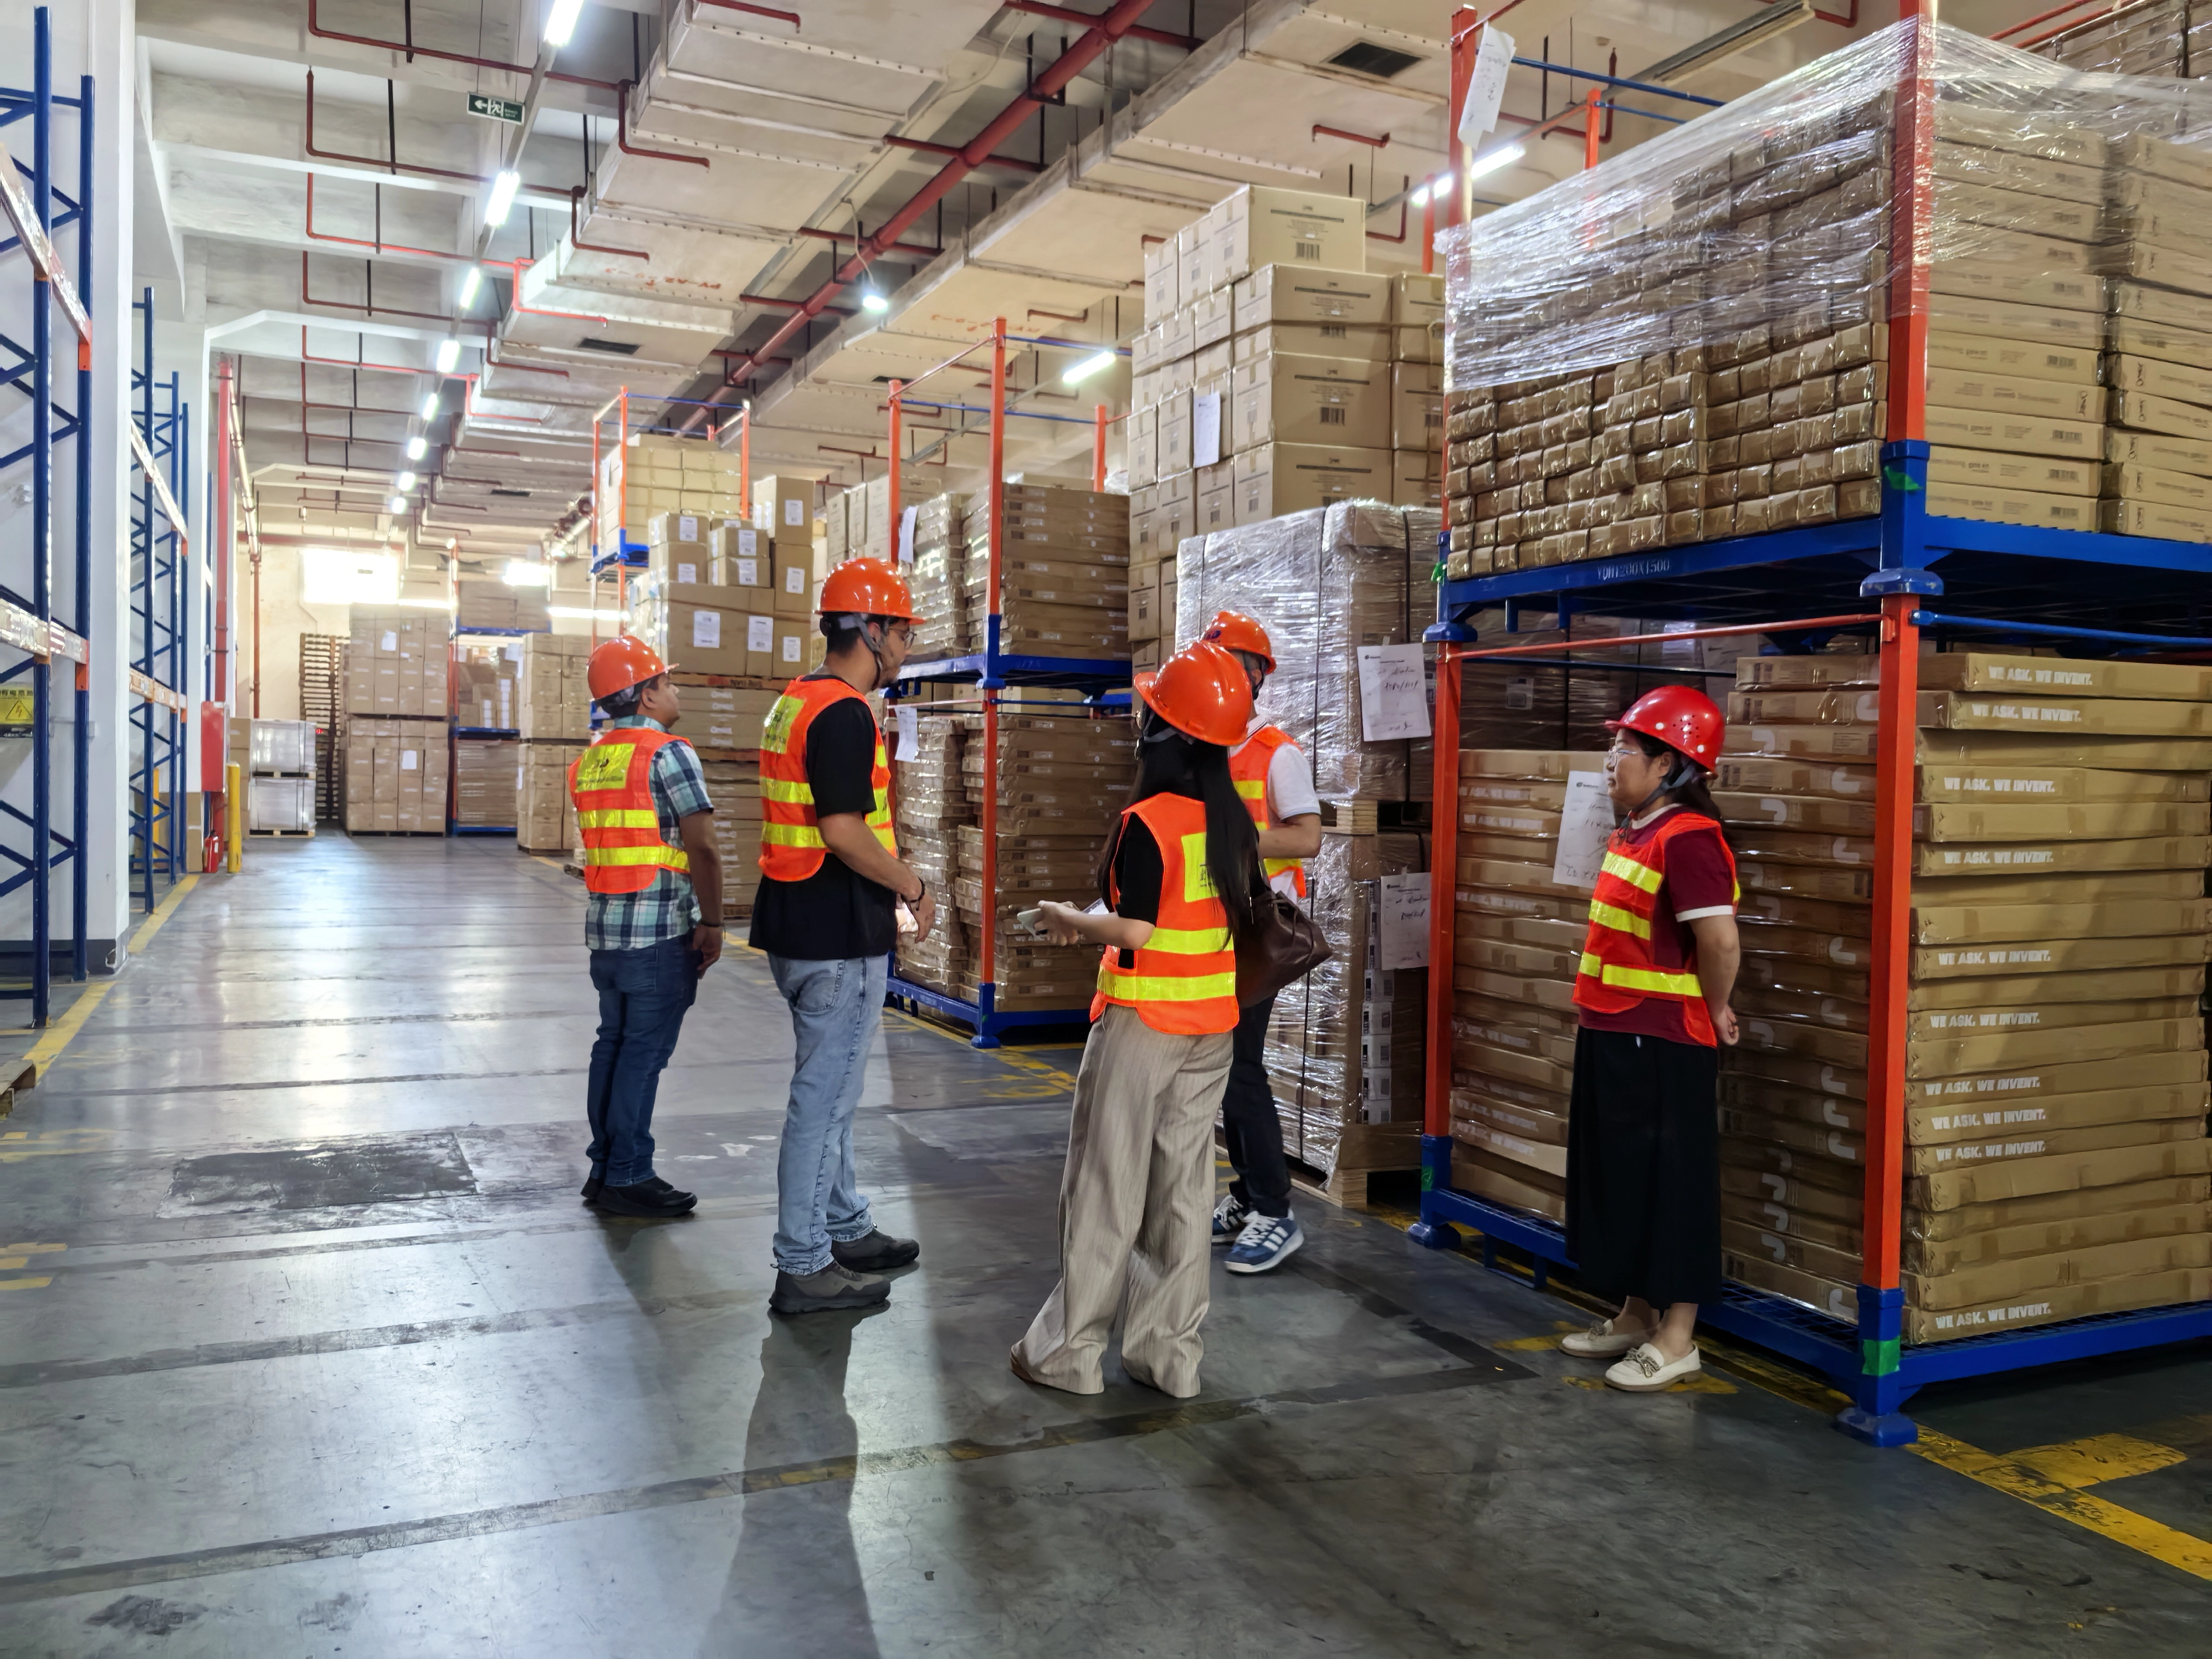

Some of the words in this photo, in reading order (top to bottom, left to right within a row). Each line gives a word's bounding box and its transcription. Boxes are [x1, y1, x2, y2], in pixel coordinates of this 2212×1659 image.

[1989, 666, 2005, 679] WE
[2007, 668, 2032, 682] ASK.
[2035, 670, 2052, 683] WE
[1972, 704, 1989, 717] WE
[1992, 705, 2019, 719] ASK.
[2021, 707, 2039, 720] WE
[1944, 777, 1960, 790] WE
[1964, 778, 1991, 791] ASK.
[1994, 779, 2011, 792] WE
[1944, 851, 1960, 864] WE
[1964, 851, 1991, 864] ASK.
[1994, 851, 2012, 864] WE
[1938, 953, 1954, 966] WE
[1958, 952, 1985, 965] ASK.
[1988, 951, 2007, 963] WE
[1930, 1015, 1947, 1028] WE
[1949, 1014, 1975, 1027] ASK.
[1980, 1014, 1997, 1026] WE
[1925, 1082, 1942, 1096] WE
[1944, 1081, 1972, 1094] ASK.
[1977, 1080, 1994, 1092] WE
[1931, 1116, 1951, 1130] WE
[1952, 1114, 1980, 1128] ASK.
[1982, 1111, 2001, 1125] WE
[1936, 1148, 1953, 1162] WE
[1955, 1146, 1982, 1159] ASK.
[1985, 1144, 2003, 1157] WE
[1935, 1314, 1954, 1329] WE
[1956, 1312, 1985, 1327] ASK.
[1987, 1308, 2006, 1323] WE
